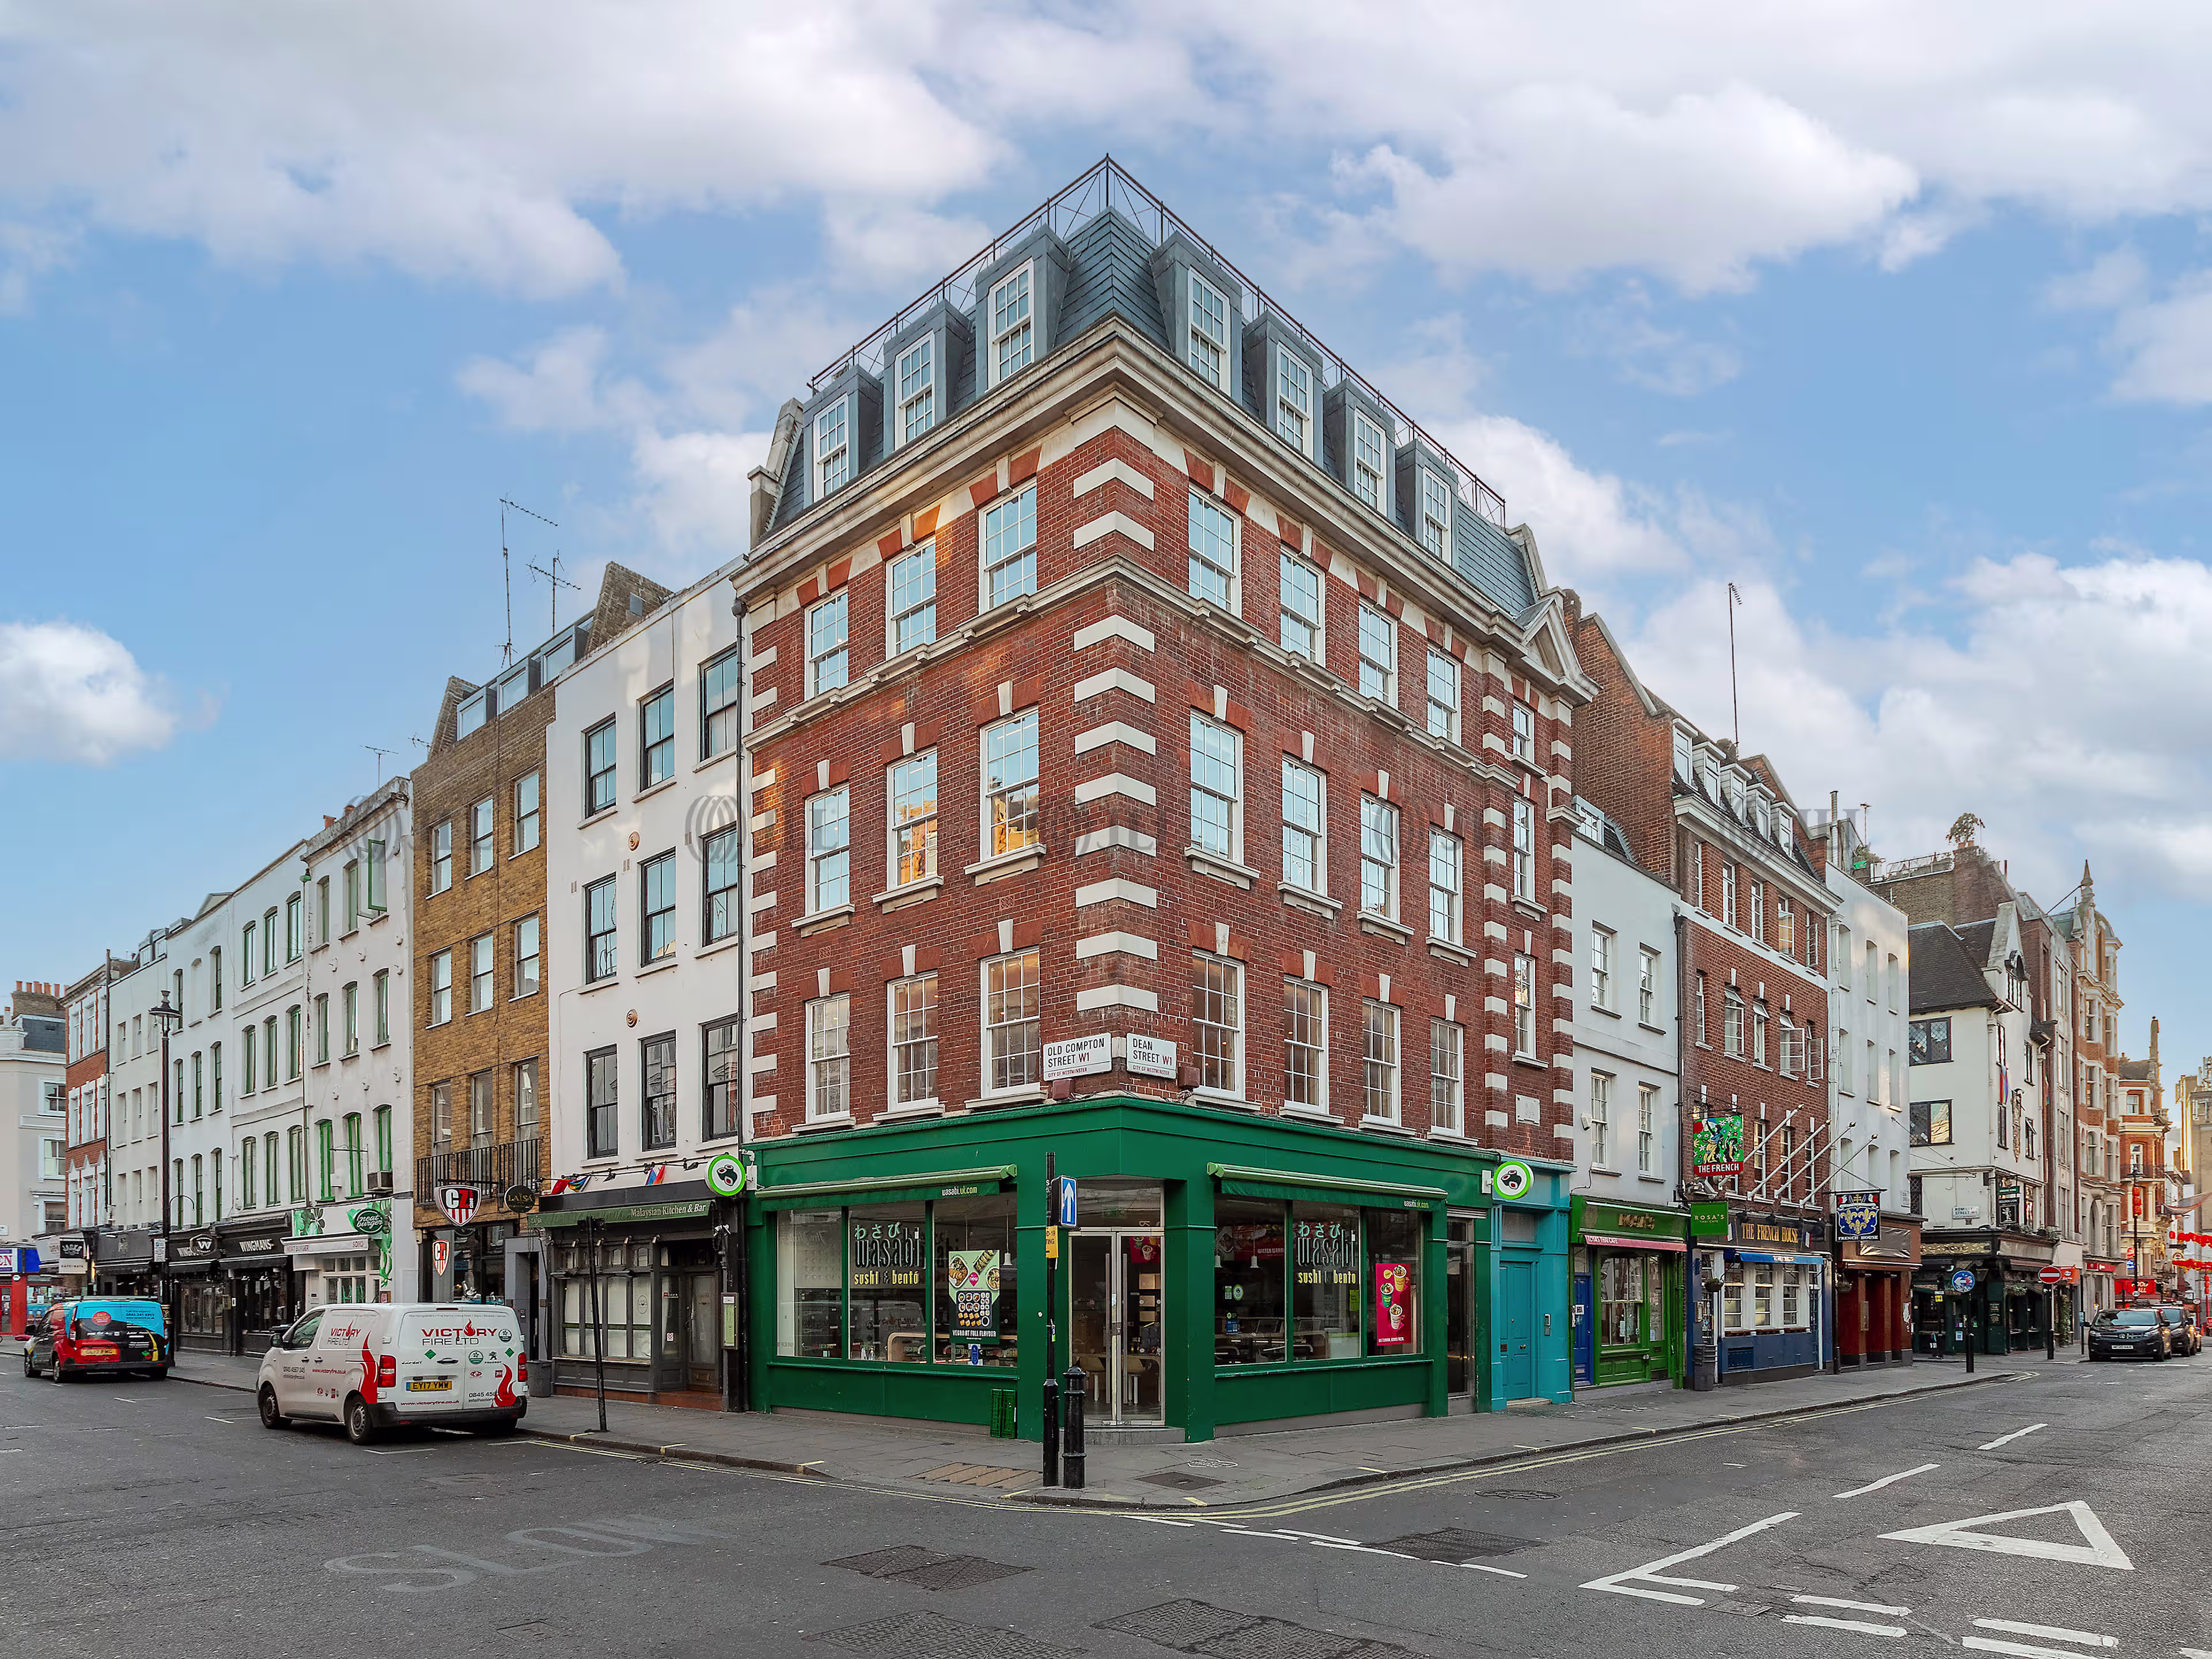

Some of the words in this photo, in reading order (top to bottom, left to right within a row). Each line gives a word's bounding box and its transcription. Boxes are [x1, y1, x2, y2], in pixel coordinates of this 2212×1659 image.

[1048, 1046, 1062, 1056] OLD
[1066, 1037, 1105, 1053] COMPTON
[1133, 1038, 1153, 1051] DEAN
[1048, 1054, 1076, 1067] STREET
[1078, 1052, 1090, 1063] W1
[1133, 1050, 1160, 1063] STREET
[1162, 1056, 1172, 1066] W1
[1062, 1067, 1088, 1075] WESTMINSTER
[1147, 1067, 1170, 1075] WESTMINSTER
[1698, 1165, 1710, 1173] THE
[1711, 1163, 1740, 1173] FRENCH
[942, 1185, 978, 1196] wasabi.uk.com
[631, 1207, 661, 1217] Malaysian
[662, 1205, 687, 1215] Kitchen
[687, 1204, 692, 1213] &
[694, 1203, 706, 1212] Bar
[357, 1220, 383, 1229] burger
[854, 1221, 902, 1240] わさび
[1298, 1221, 1341, 1238] わさび
[1741, 1222, 1755, 1240] THE
[1757, 1224, 1779, 1241] FRENCH
[1782, 1226, 1798, 1243] HOUSE
[240, 1239, 273, 1252] WINGMANS
[855, 1226, 920, 1268] wasabi
[1298, 1229, 1356, 1267] wasabi
[854, 1270, 879, 1285] sushi
[1298, 1269, 1321, 1284] sushi
[1334, 1269, 1356, 1284] bento
[331, 1325, 361, 1337] VICTORY
[421, 1324, 498, 1337] VICTORY
[339, 1338, 350, 1346] LTD
[422, 1338, 452, 1346] FIRE
[456, 1337, 479, 1345] LTD
